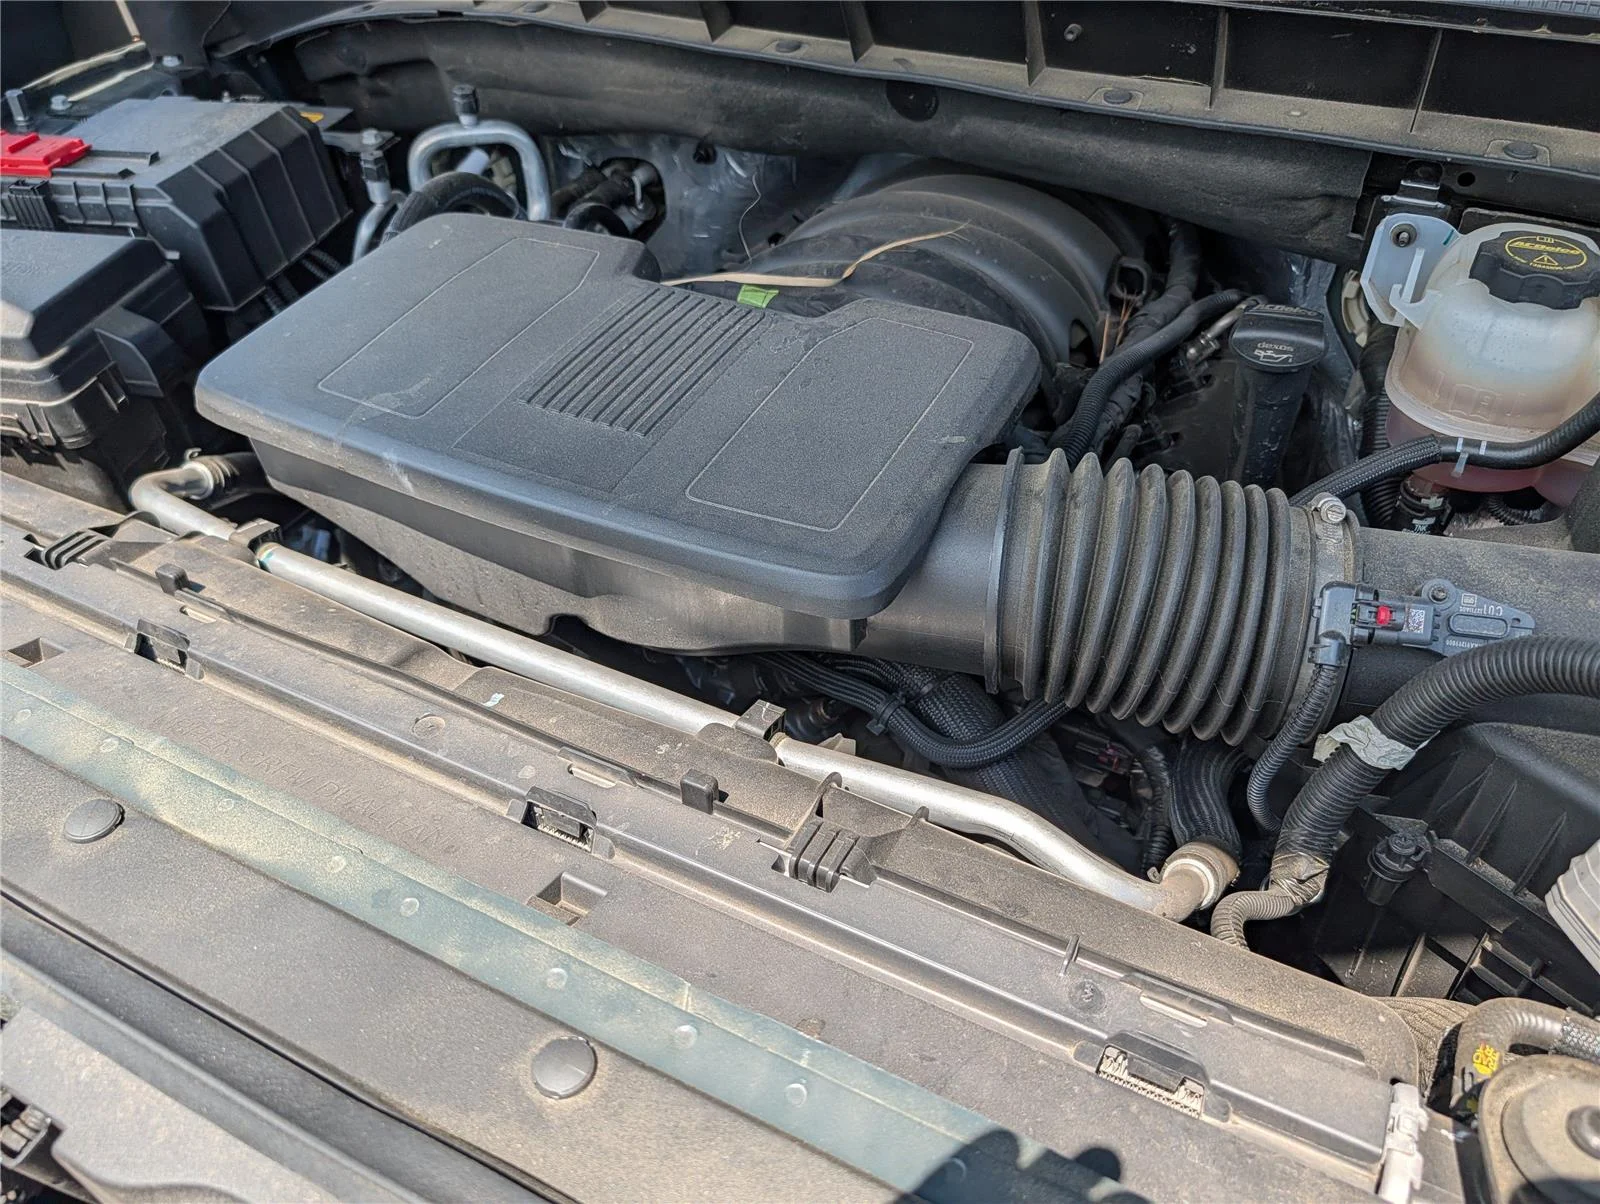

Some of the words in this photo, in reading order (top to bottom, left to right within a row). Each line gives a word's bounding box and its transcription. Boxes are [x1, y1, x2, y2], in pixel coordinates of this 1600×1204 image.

[1509, 240, 1580, 254] ACDelco
[1252, 304, 1318, 317] ACDelco
[1257, 341, 1294, 352] dexos
[312, 781, 386, 821] DUAL
[386, 814, 457, 846] FAN
